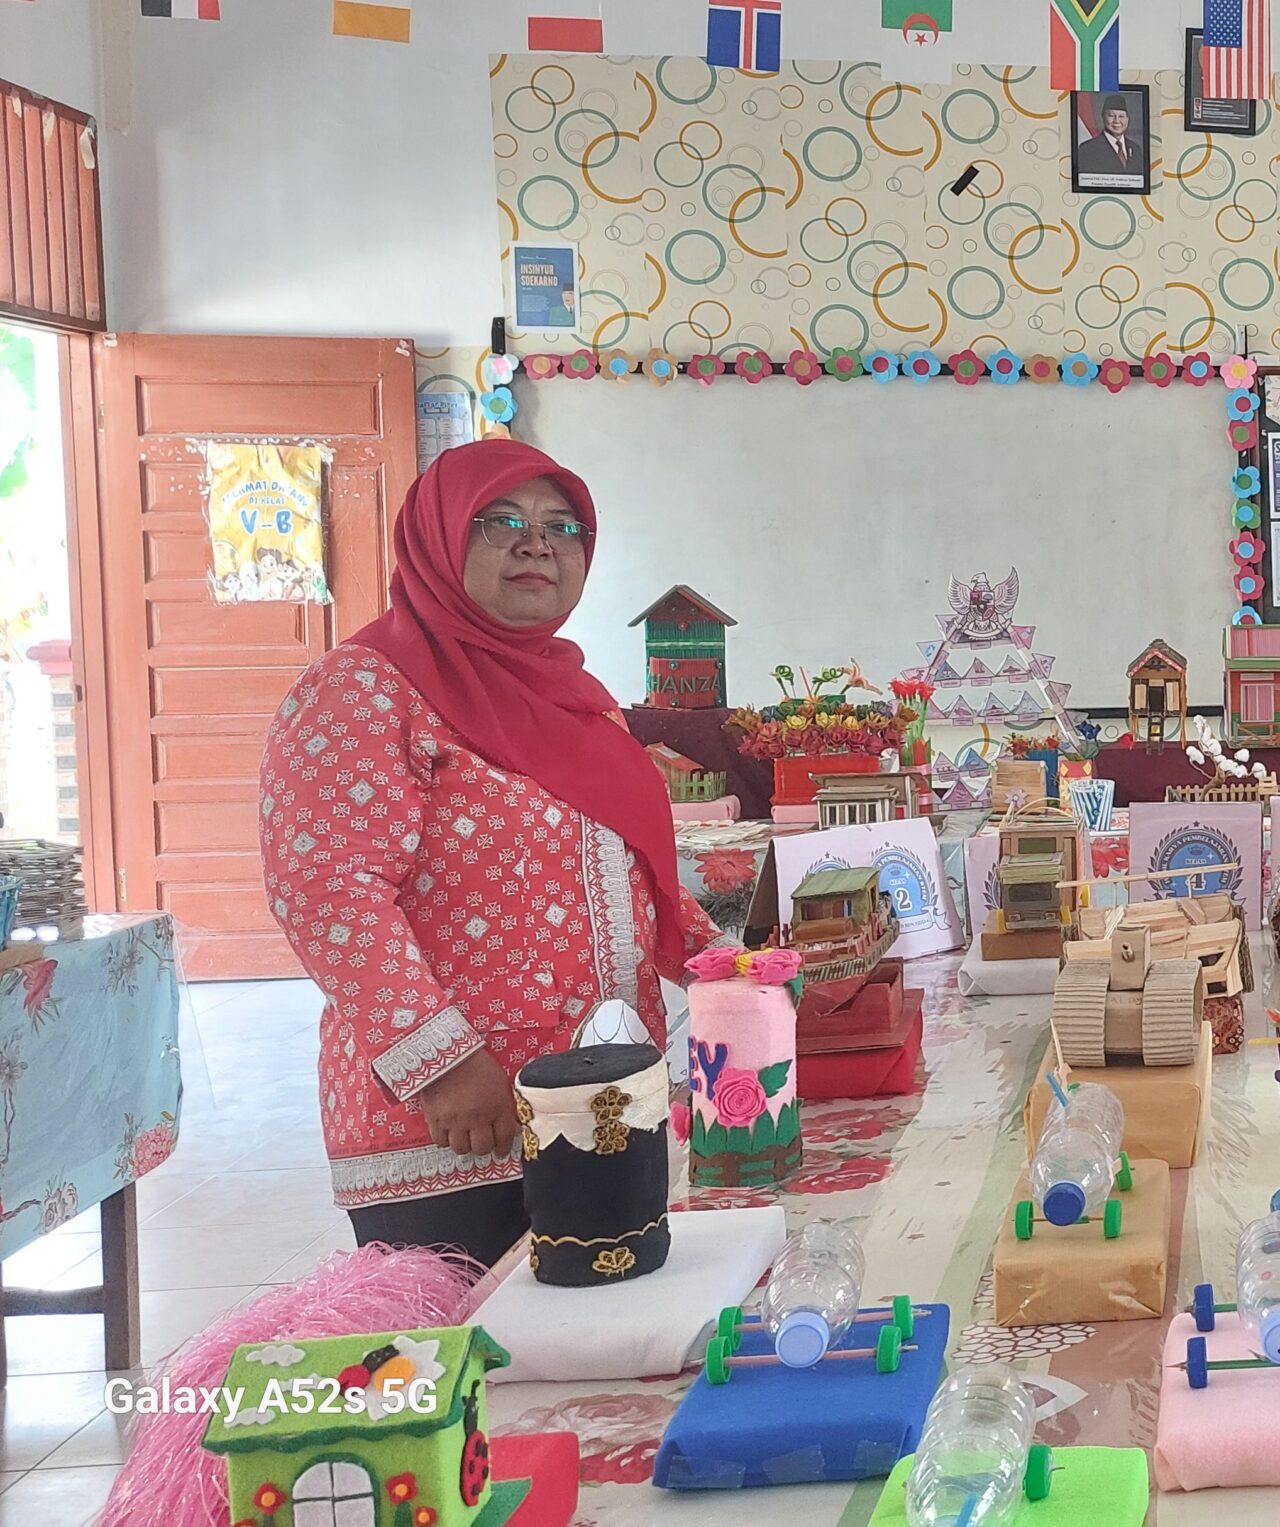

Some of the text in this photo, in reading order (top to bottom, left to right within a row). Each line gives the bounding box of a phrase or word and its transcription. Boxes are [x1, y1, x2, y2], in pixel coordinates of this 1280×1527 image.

[520, 263, 554, 275] INSINYUR
[520, 275, 558, 287] SOEKARNO
[895, 888, 913, 912] 2
